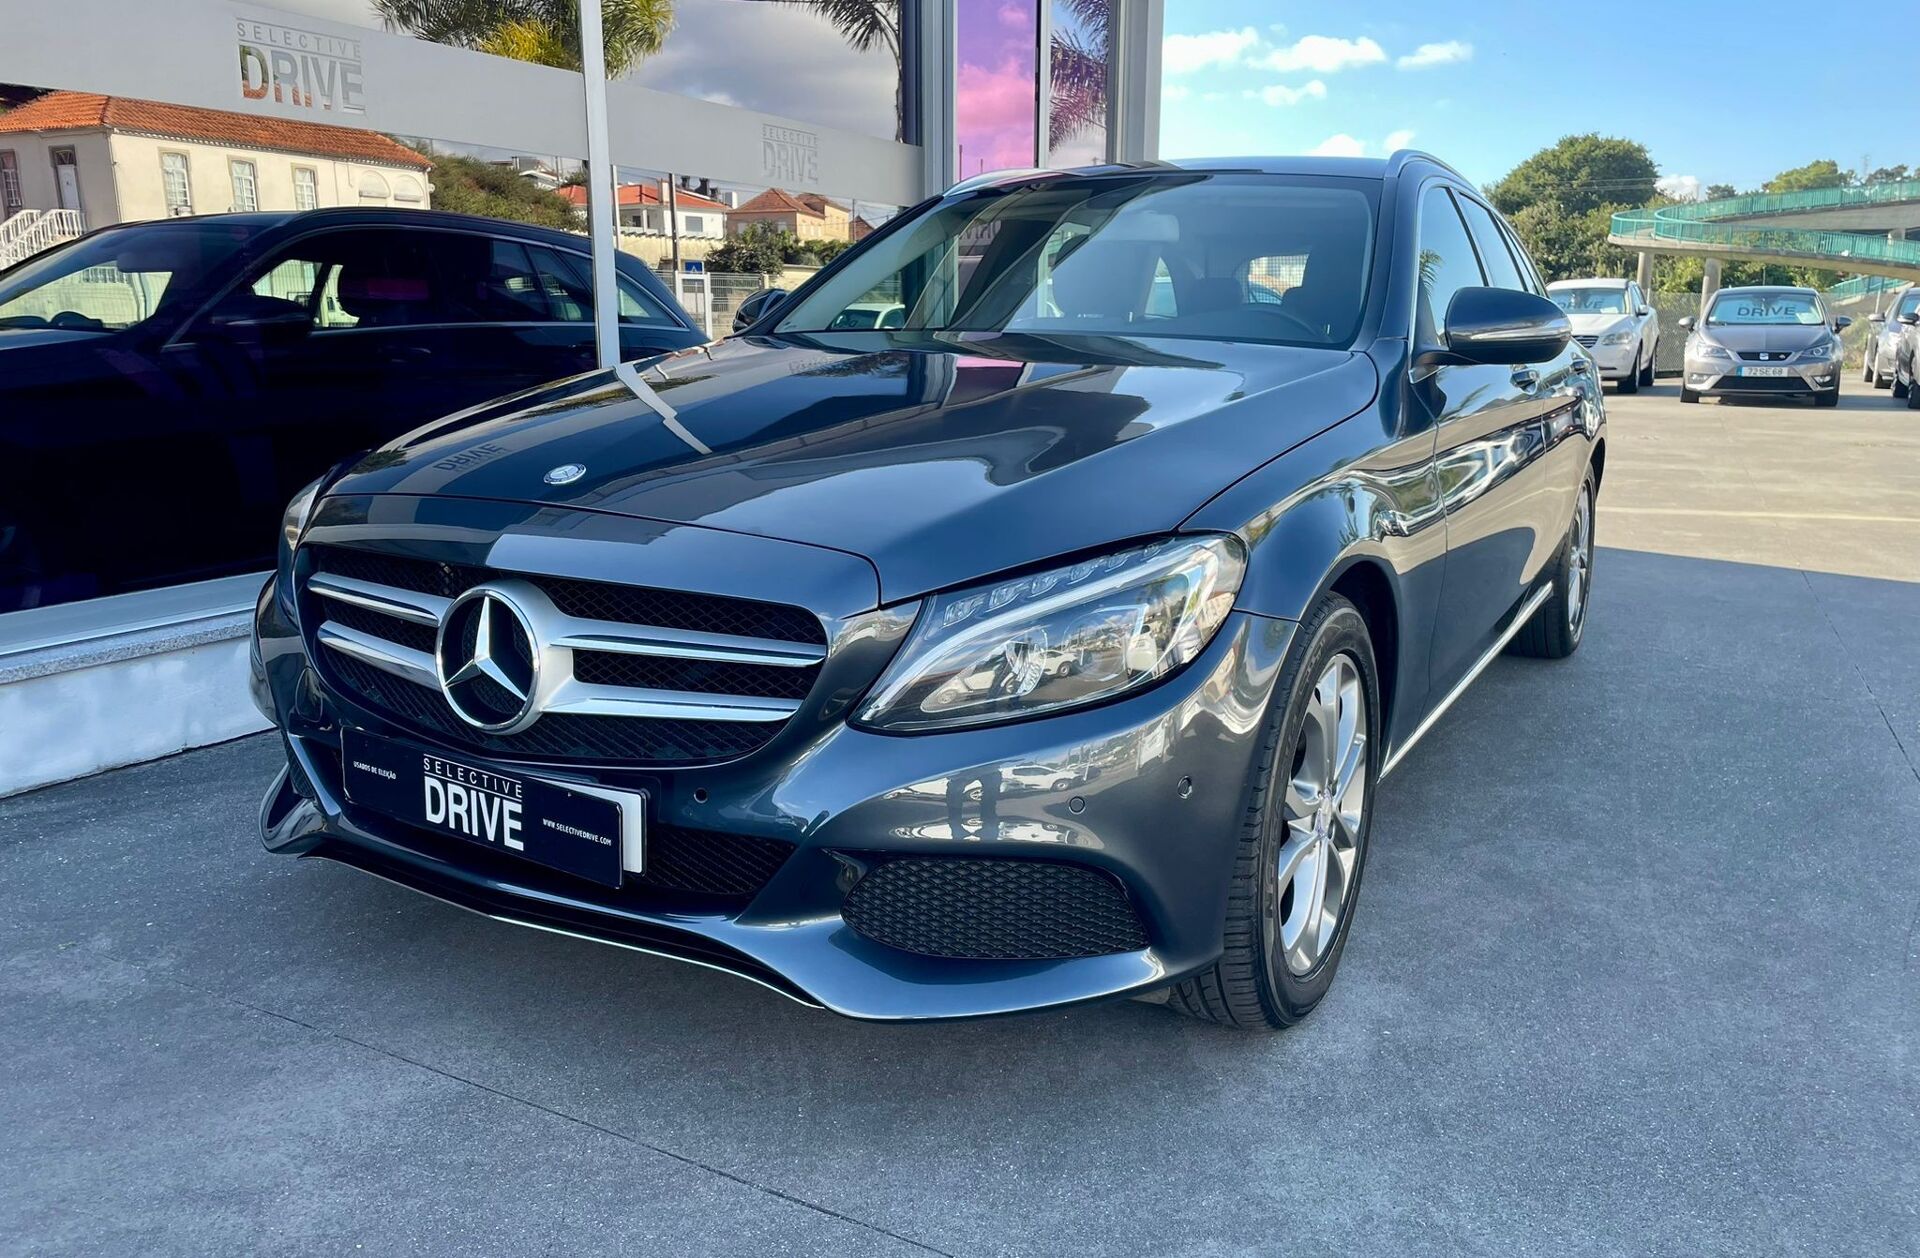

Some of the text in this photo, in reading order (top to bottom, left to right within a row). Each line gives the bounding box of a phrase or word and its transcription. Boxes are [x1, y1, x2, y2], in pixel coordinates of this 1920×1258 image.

[236, 22, 361, 59] SELECTIVE
[238, 44, 365, 114] DRIVE
[762, 126, 816, 147] SELECTIVE
[762, 141, 818, 184] DRIVE
[1737, 306, 1796, 317] DRIVE
[423, 757, 523, 799] SELECTIVE
[424, 775, 525, 852] DRIVE
[542, 817, 612, 847] WWW.SELECTIVEDRIVE.COM
